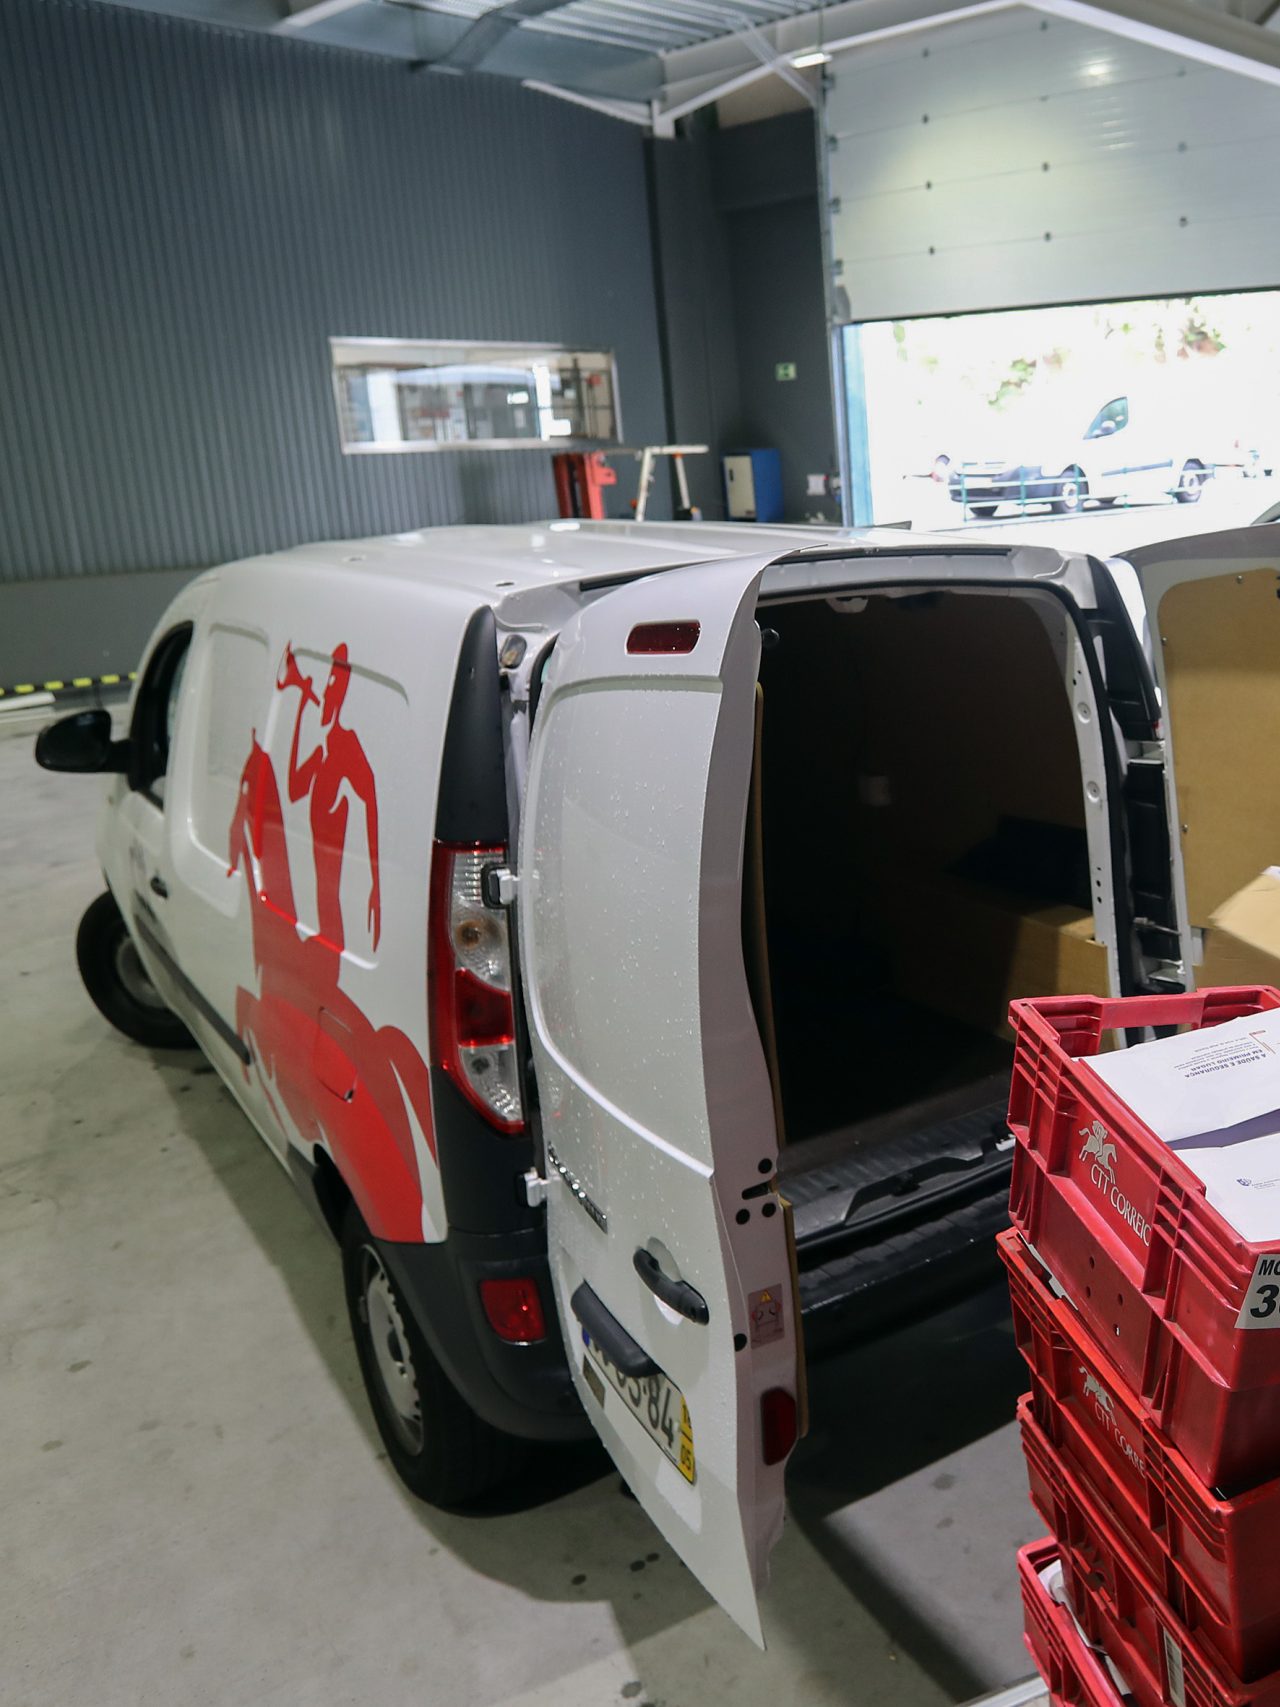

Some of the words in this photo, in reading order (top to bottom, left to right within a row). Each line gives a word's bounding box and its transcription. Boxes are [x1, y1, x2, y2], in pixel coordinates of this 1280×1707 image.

[1091, 1163, 1111, 1195] CTT
[1110, 1185, 1152, 1247] CORREIO
[1094, 1402, 1110, 1431] CTT
[1114, 1427, 1147, 1479] CORRE
